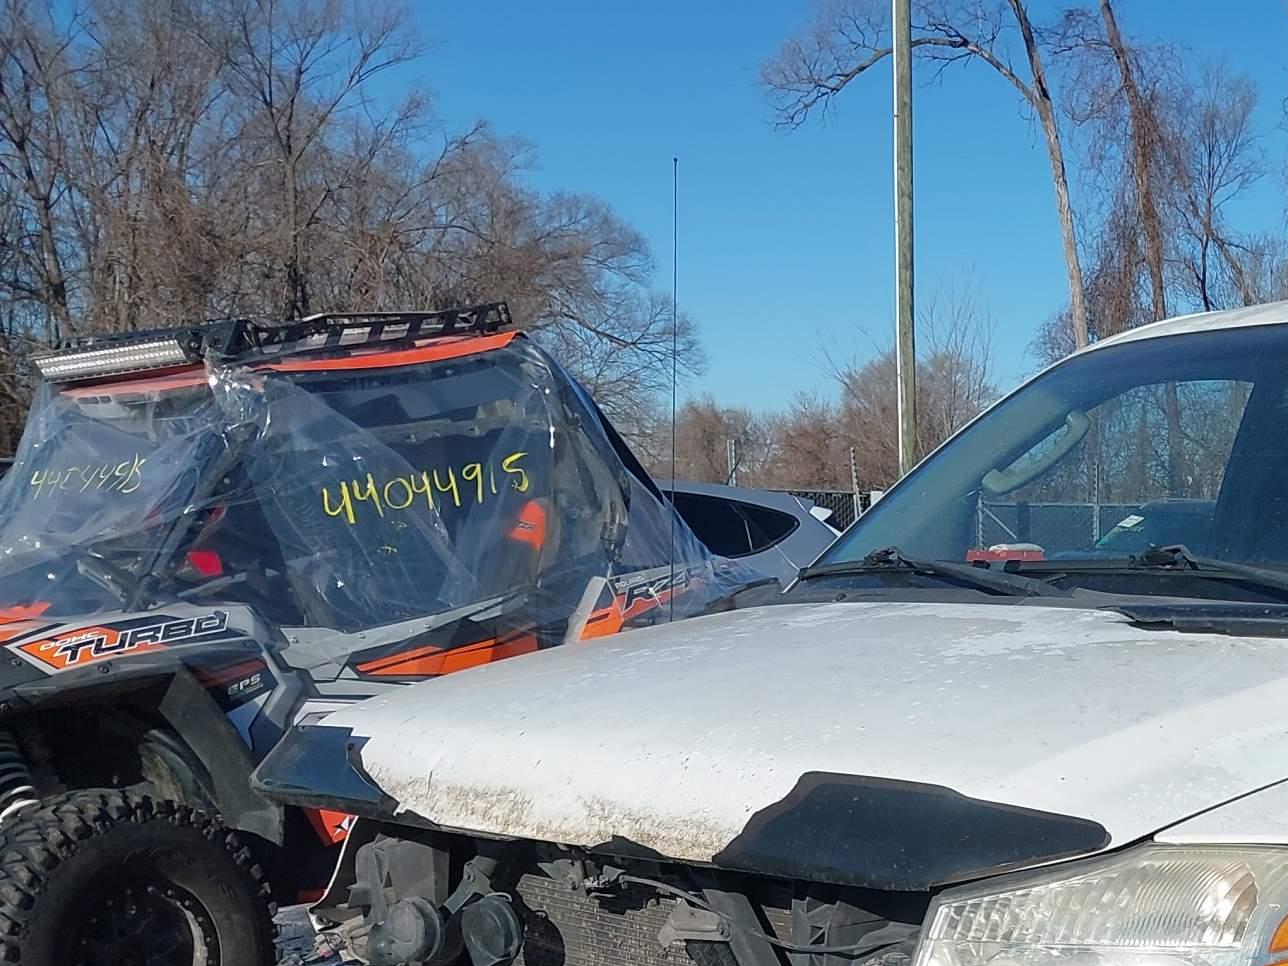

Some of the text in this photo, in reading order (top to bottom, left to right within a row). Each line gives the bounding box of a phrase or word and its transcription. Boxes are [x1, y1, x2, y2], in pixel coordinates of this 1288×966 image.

[322, 452, 529, 524] 44044915
[39, 631, 101, 651] DOHC
[53, 611, 230, 666] TURBO
[228, 673, 261, 695] EPS
